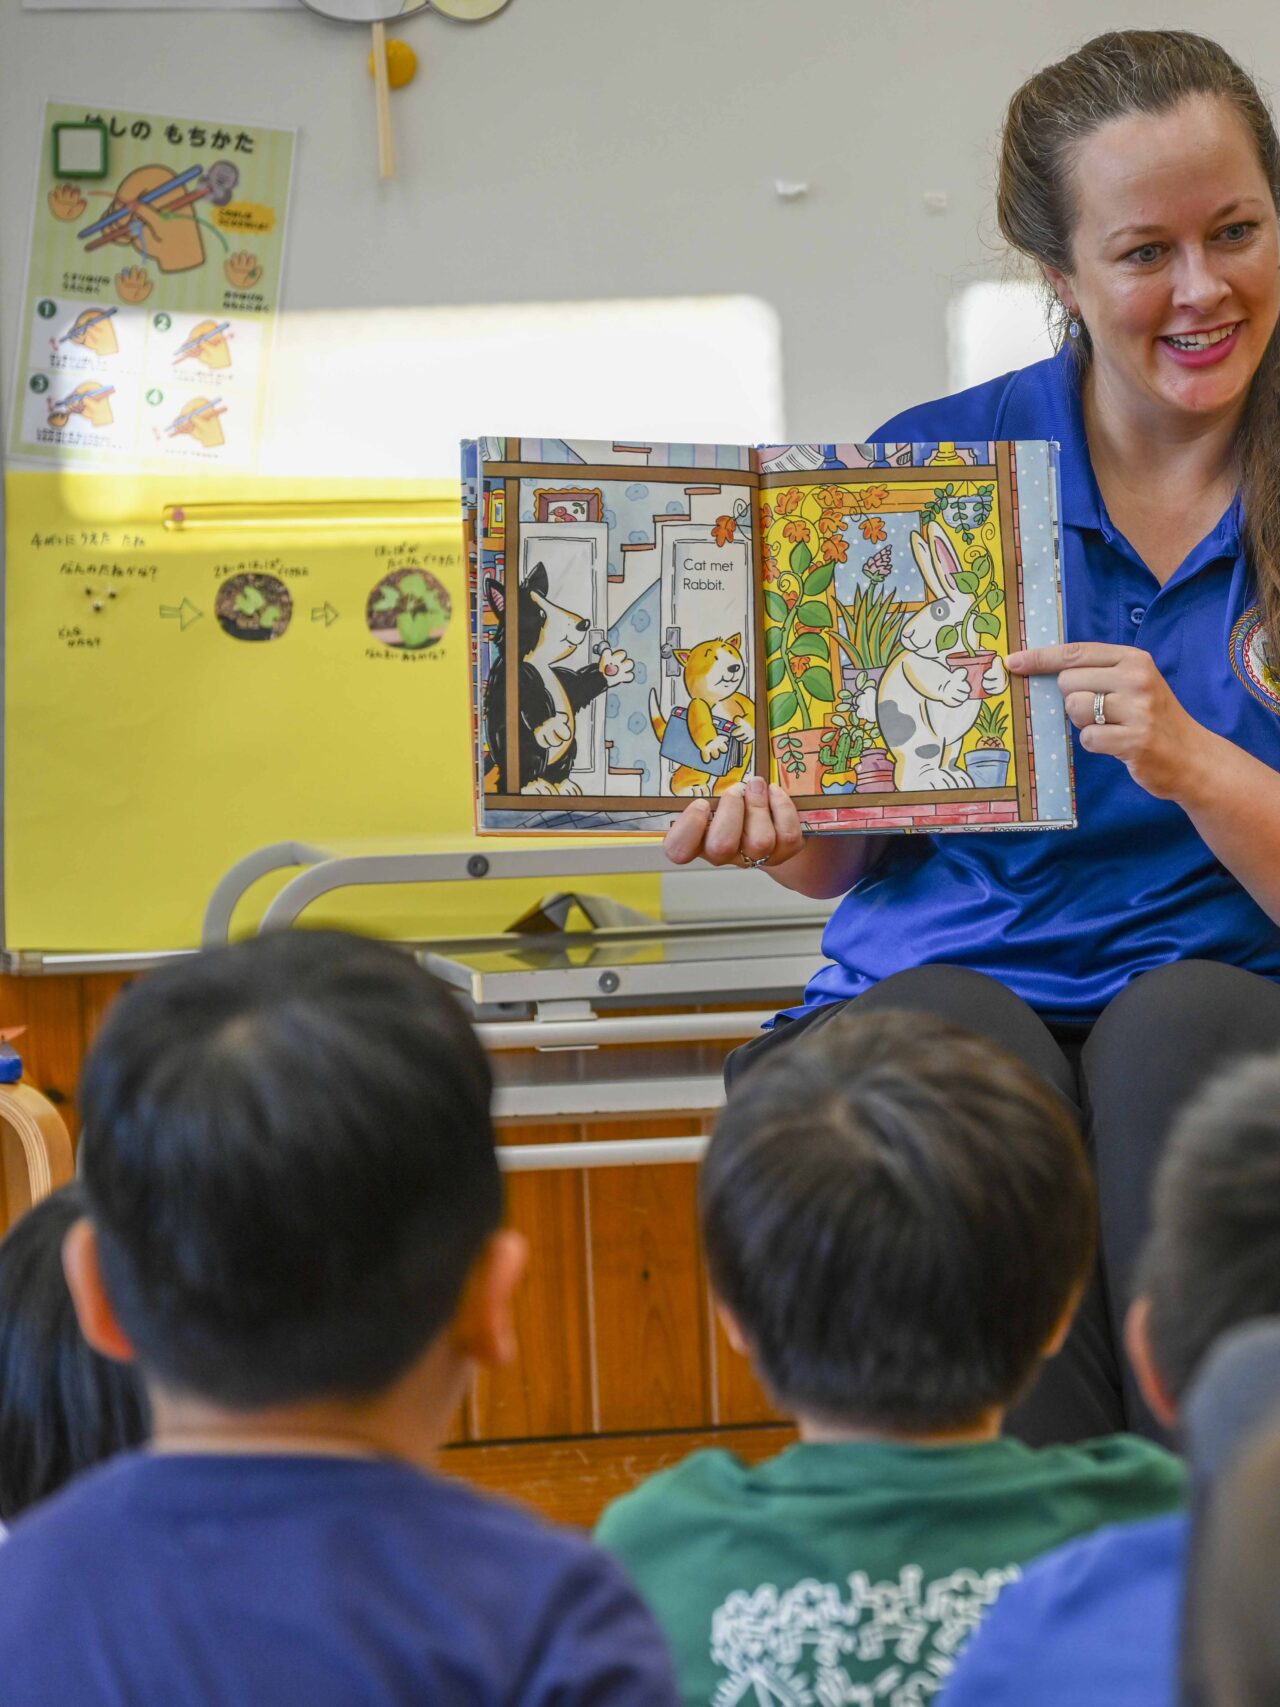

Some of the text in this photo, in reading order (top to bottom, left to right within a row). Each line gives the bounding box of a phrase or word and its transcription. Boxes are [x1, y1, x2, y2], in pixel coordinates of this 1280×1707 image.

[165, 122, 255, 154] もちかた
[683, 558, 734, 571] Cat met
[683, 577, 725, 591] Rabbit.
